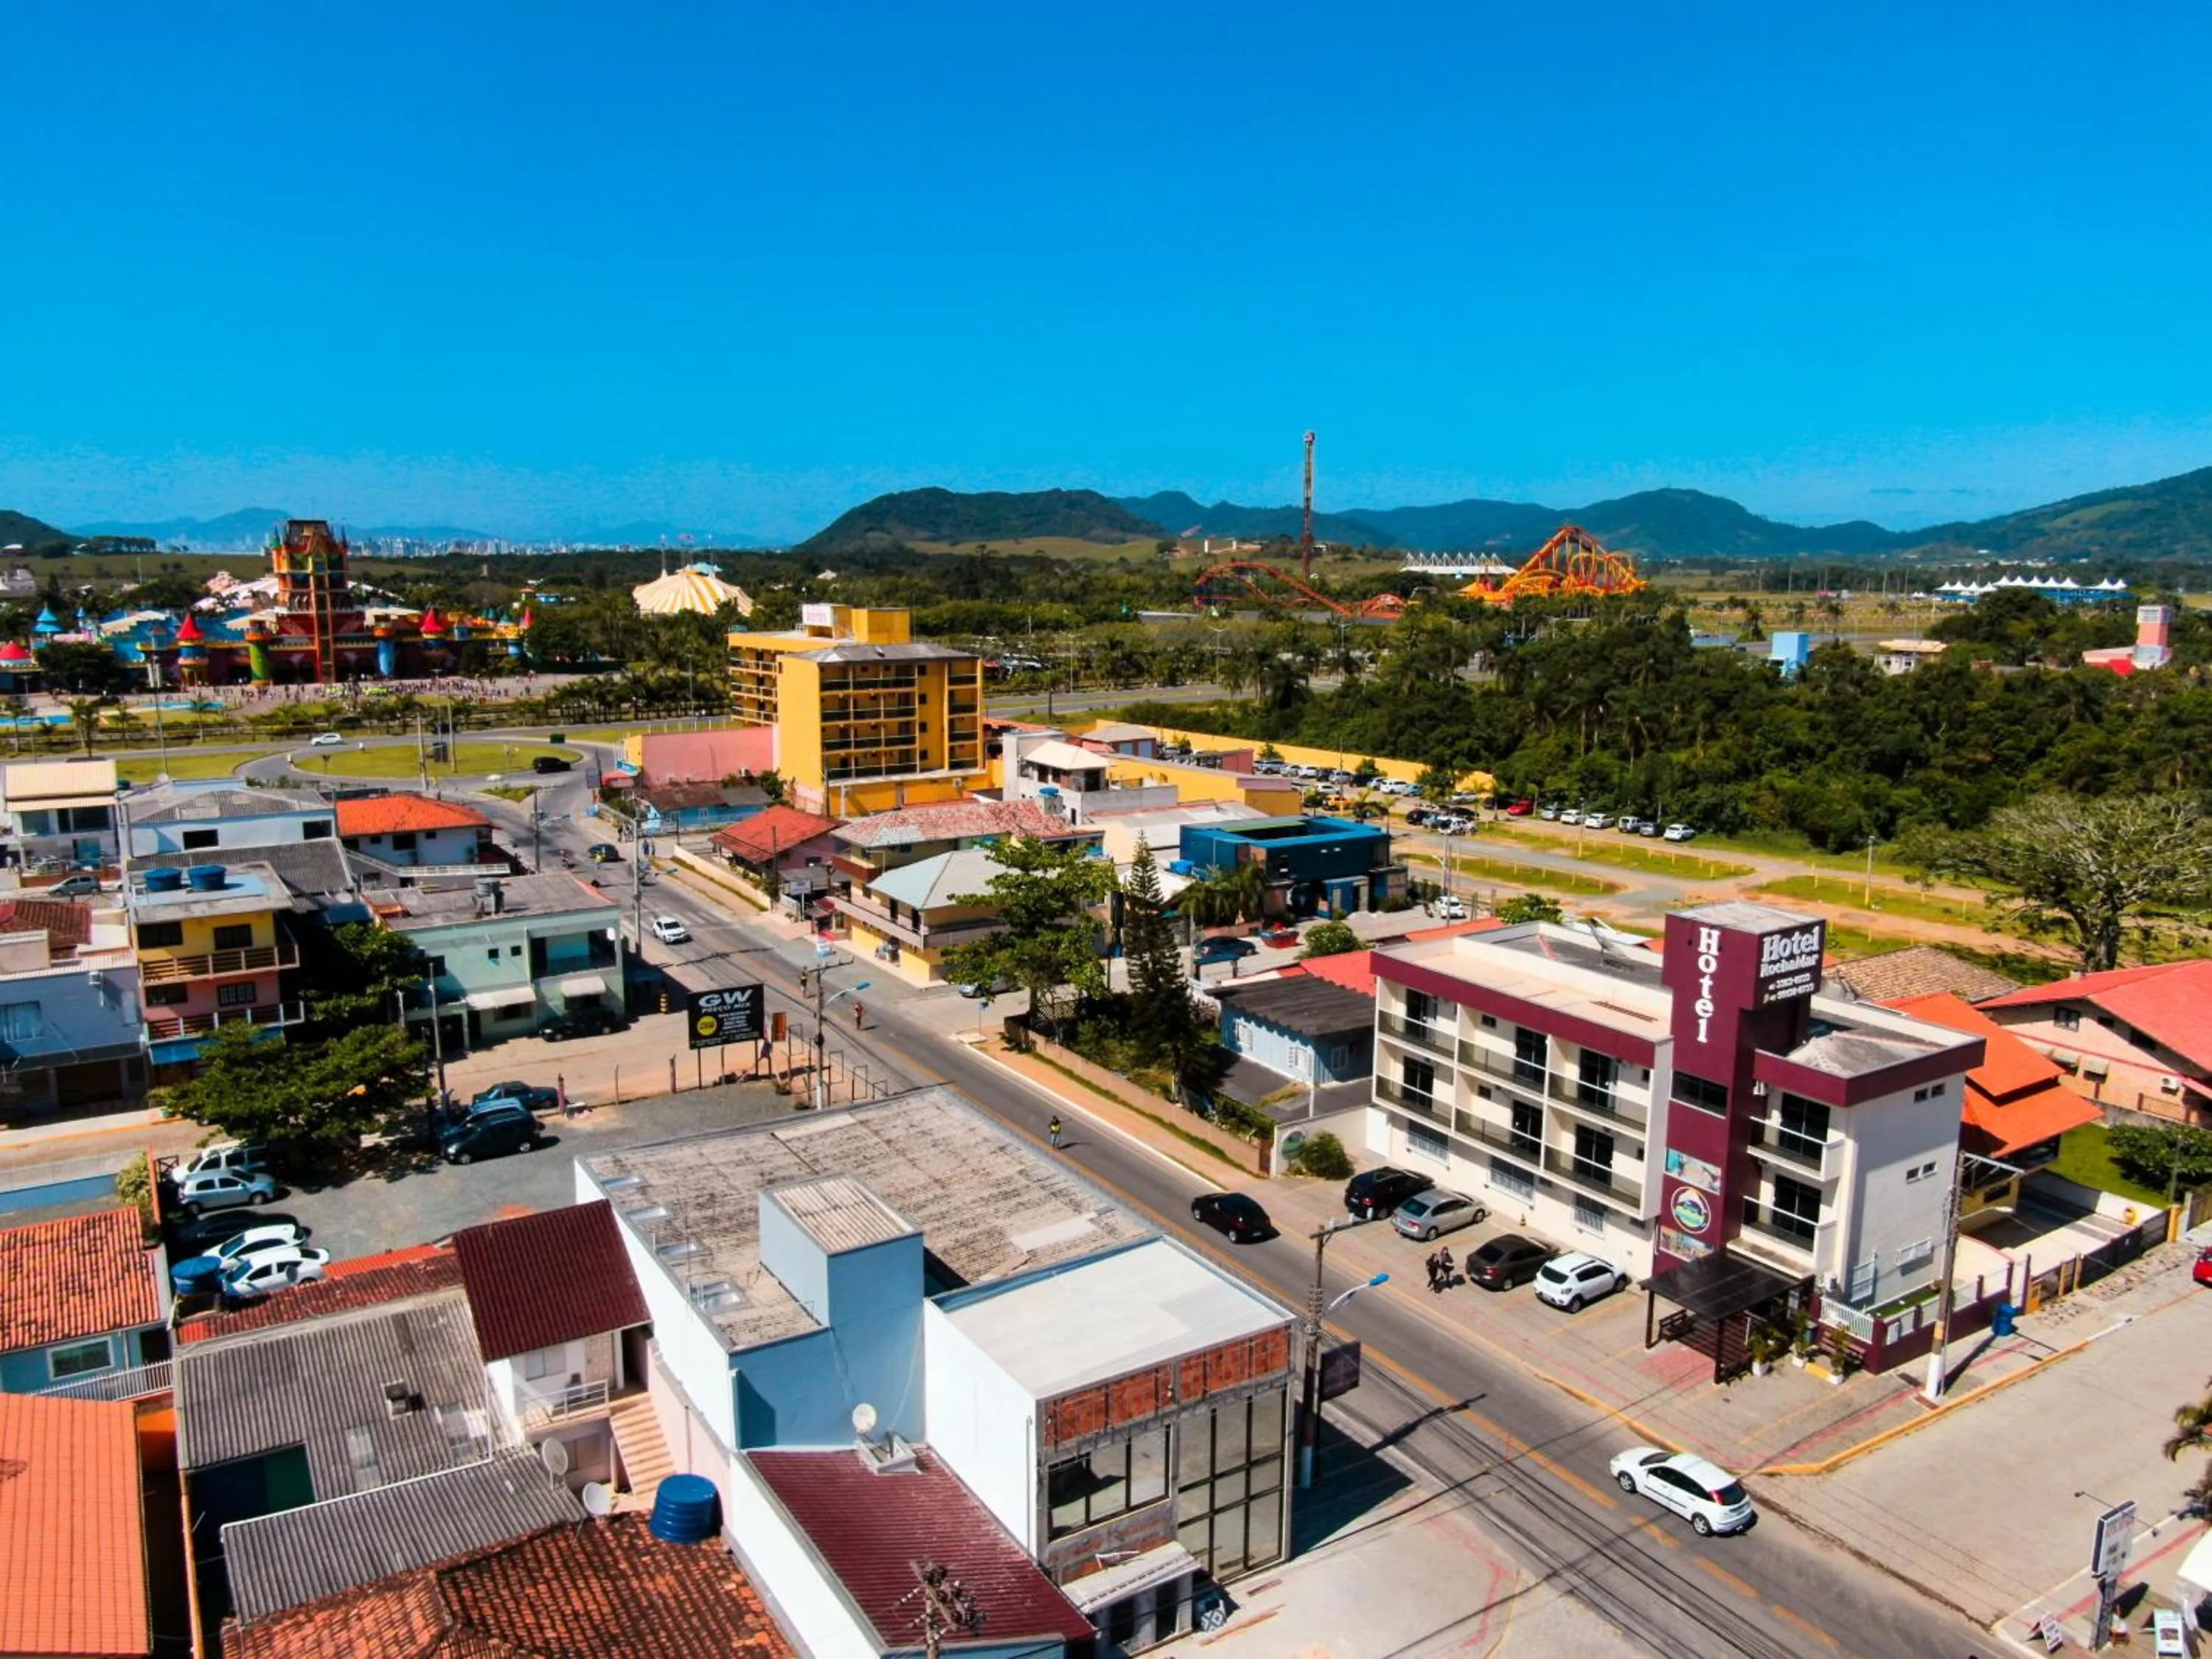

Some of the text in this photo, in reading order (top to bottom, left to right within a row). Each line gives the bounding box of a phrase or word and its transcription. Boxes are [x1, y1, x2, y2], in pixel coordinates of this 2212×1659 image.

[1761, 925, 1819, 961] Hotel
[699, 990, 753, 1007] GW
[1694, 927, 1721, 1043] Hotel
